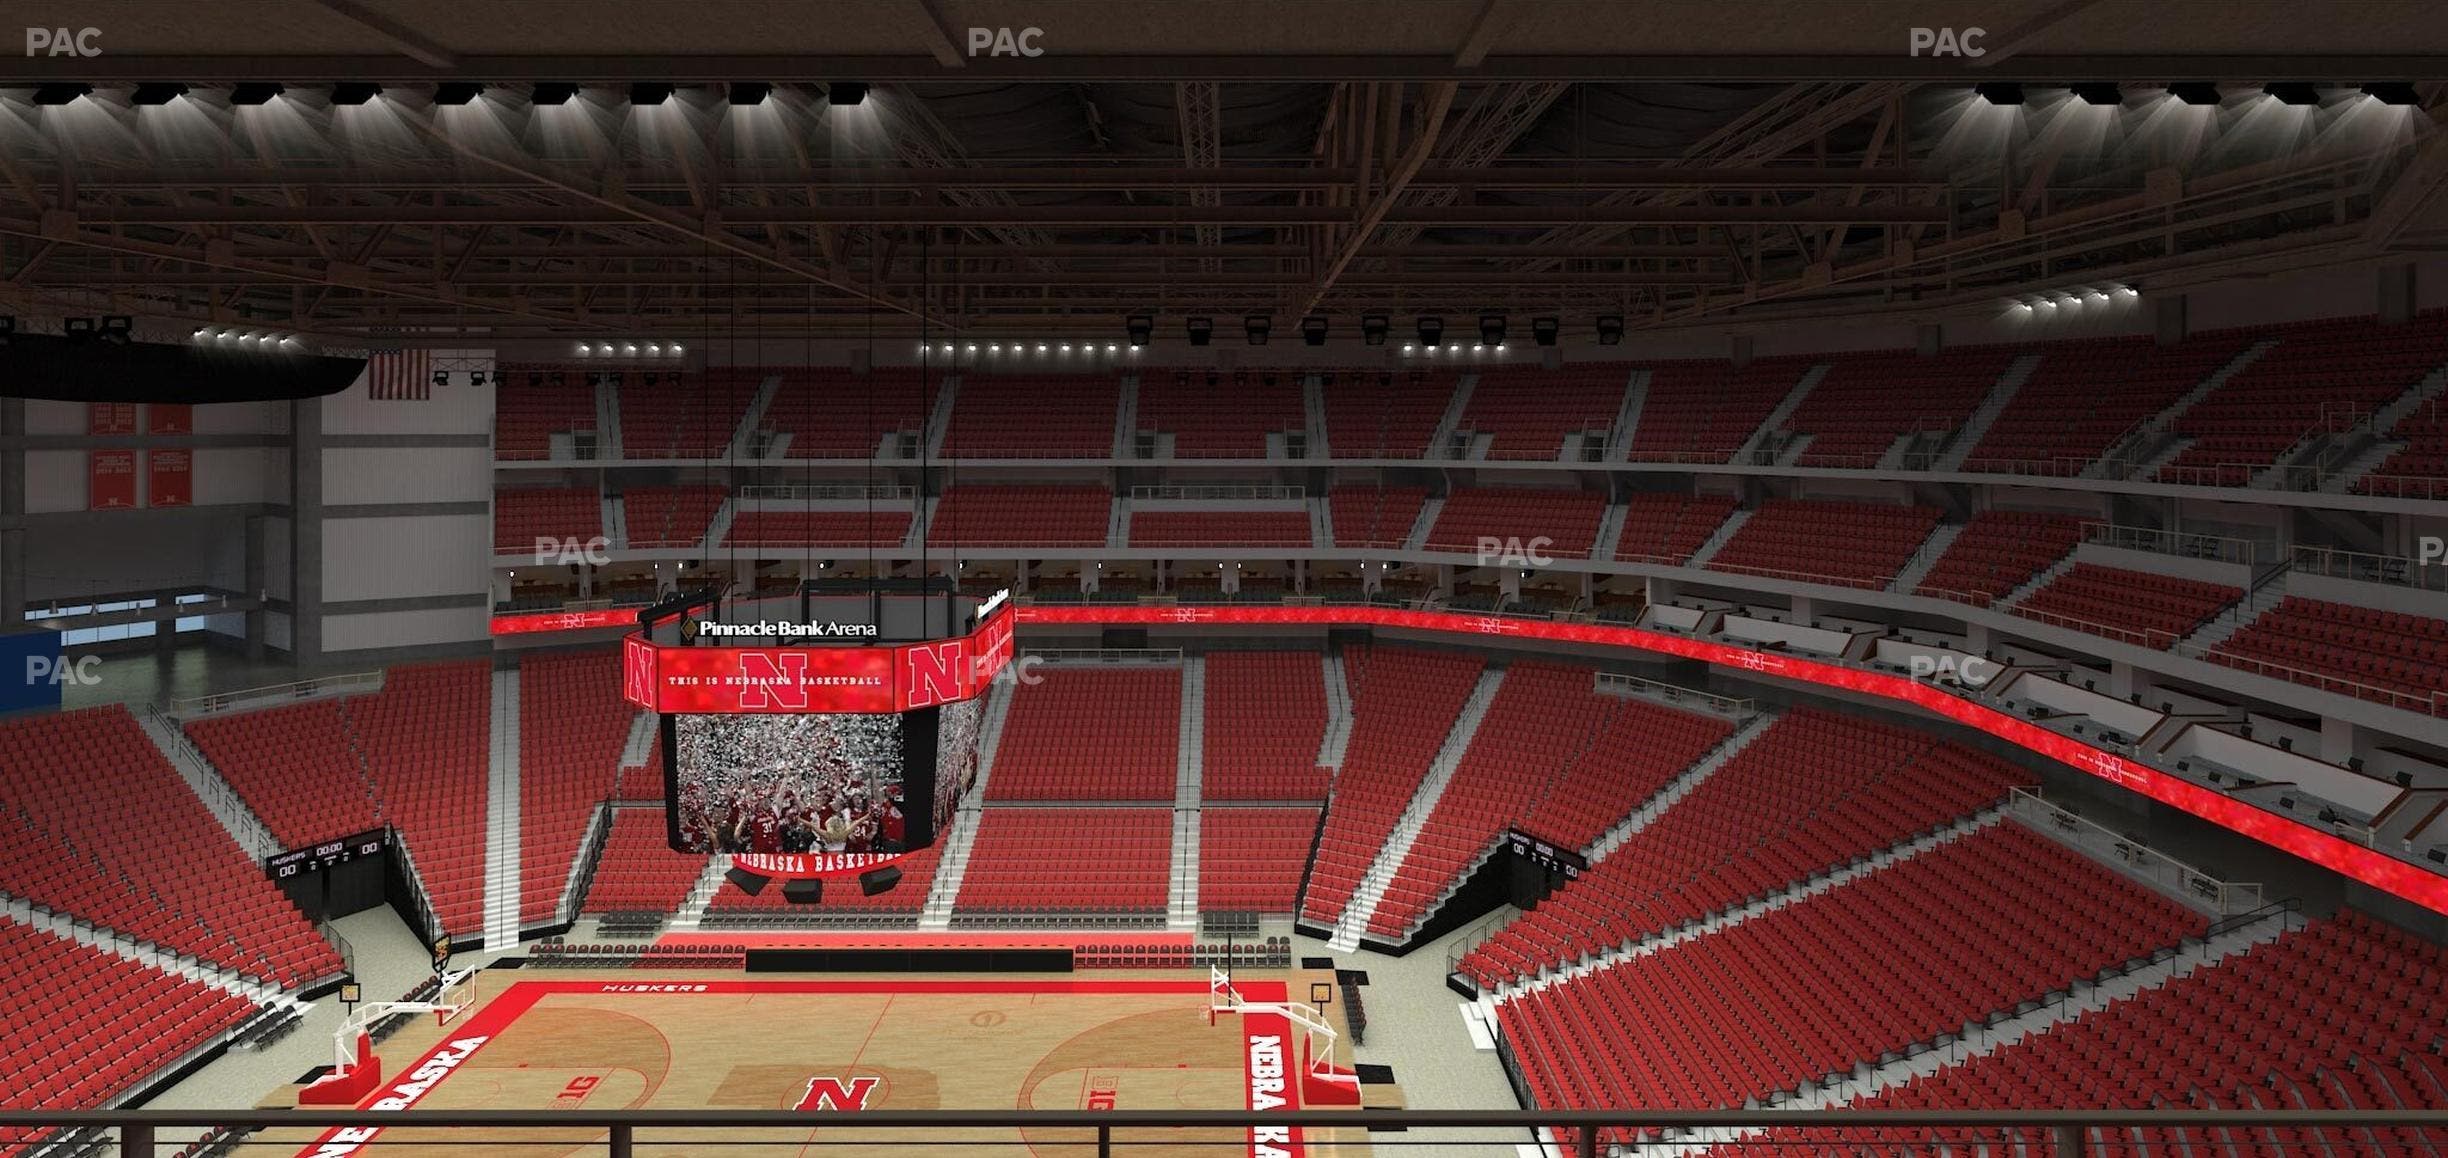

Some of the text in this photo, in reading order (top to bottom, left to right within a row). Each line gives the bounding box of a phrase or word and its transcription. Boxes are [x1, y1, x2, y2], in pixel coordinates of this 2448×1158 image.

[700, 620, 877, 636] Pinnacle Bank Arena
[629, 641, 652, 708] N
[668, 676, 882, 685] THIS IS NEBRASKA BASKETBALL
[740, 653, 807, 708] N
[908, 642, 961, 707] N
[2099, 751, 2123, 783] N
[316, 842, 343, 857] 00:00
[361, 842, 377, 855] 00
[279, 864, 296, 877] 00
[602, 984, 708, 992] HUSKERS
[307, 1036, 489, 1158] NERASKA
[792, 1077, 880, 1111] N
[1250, 1035, 1292, 1158] NEBRAKA
